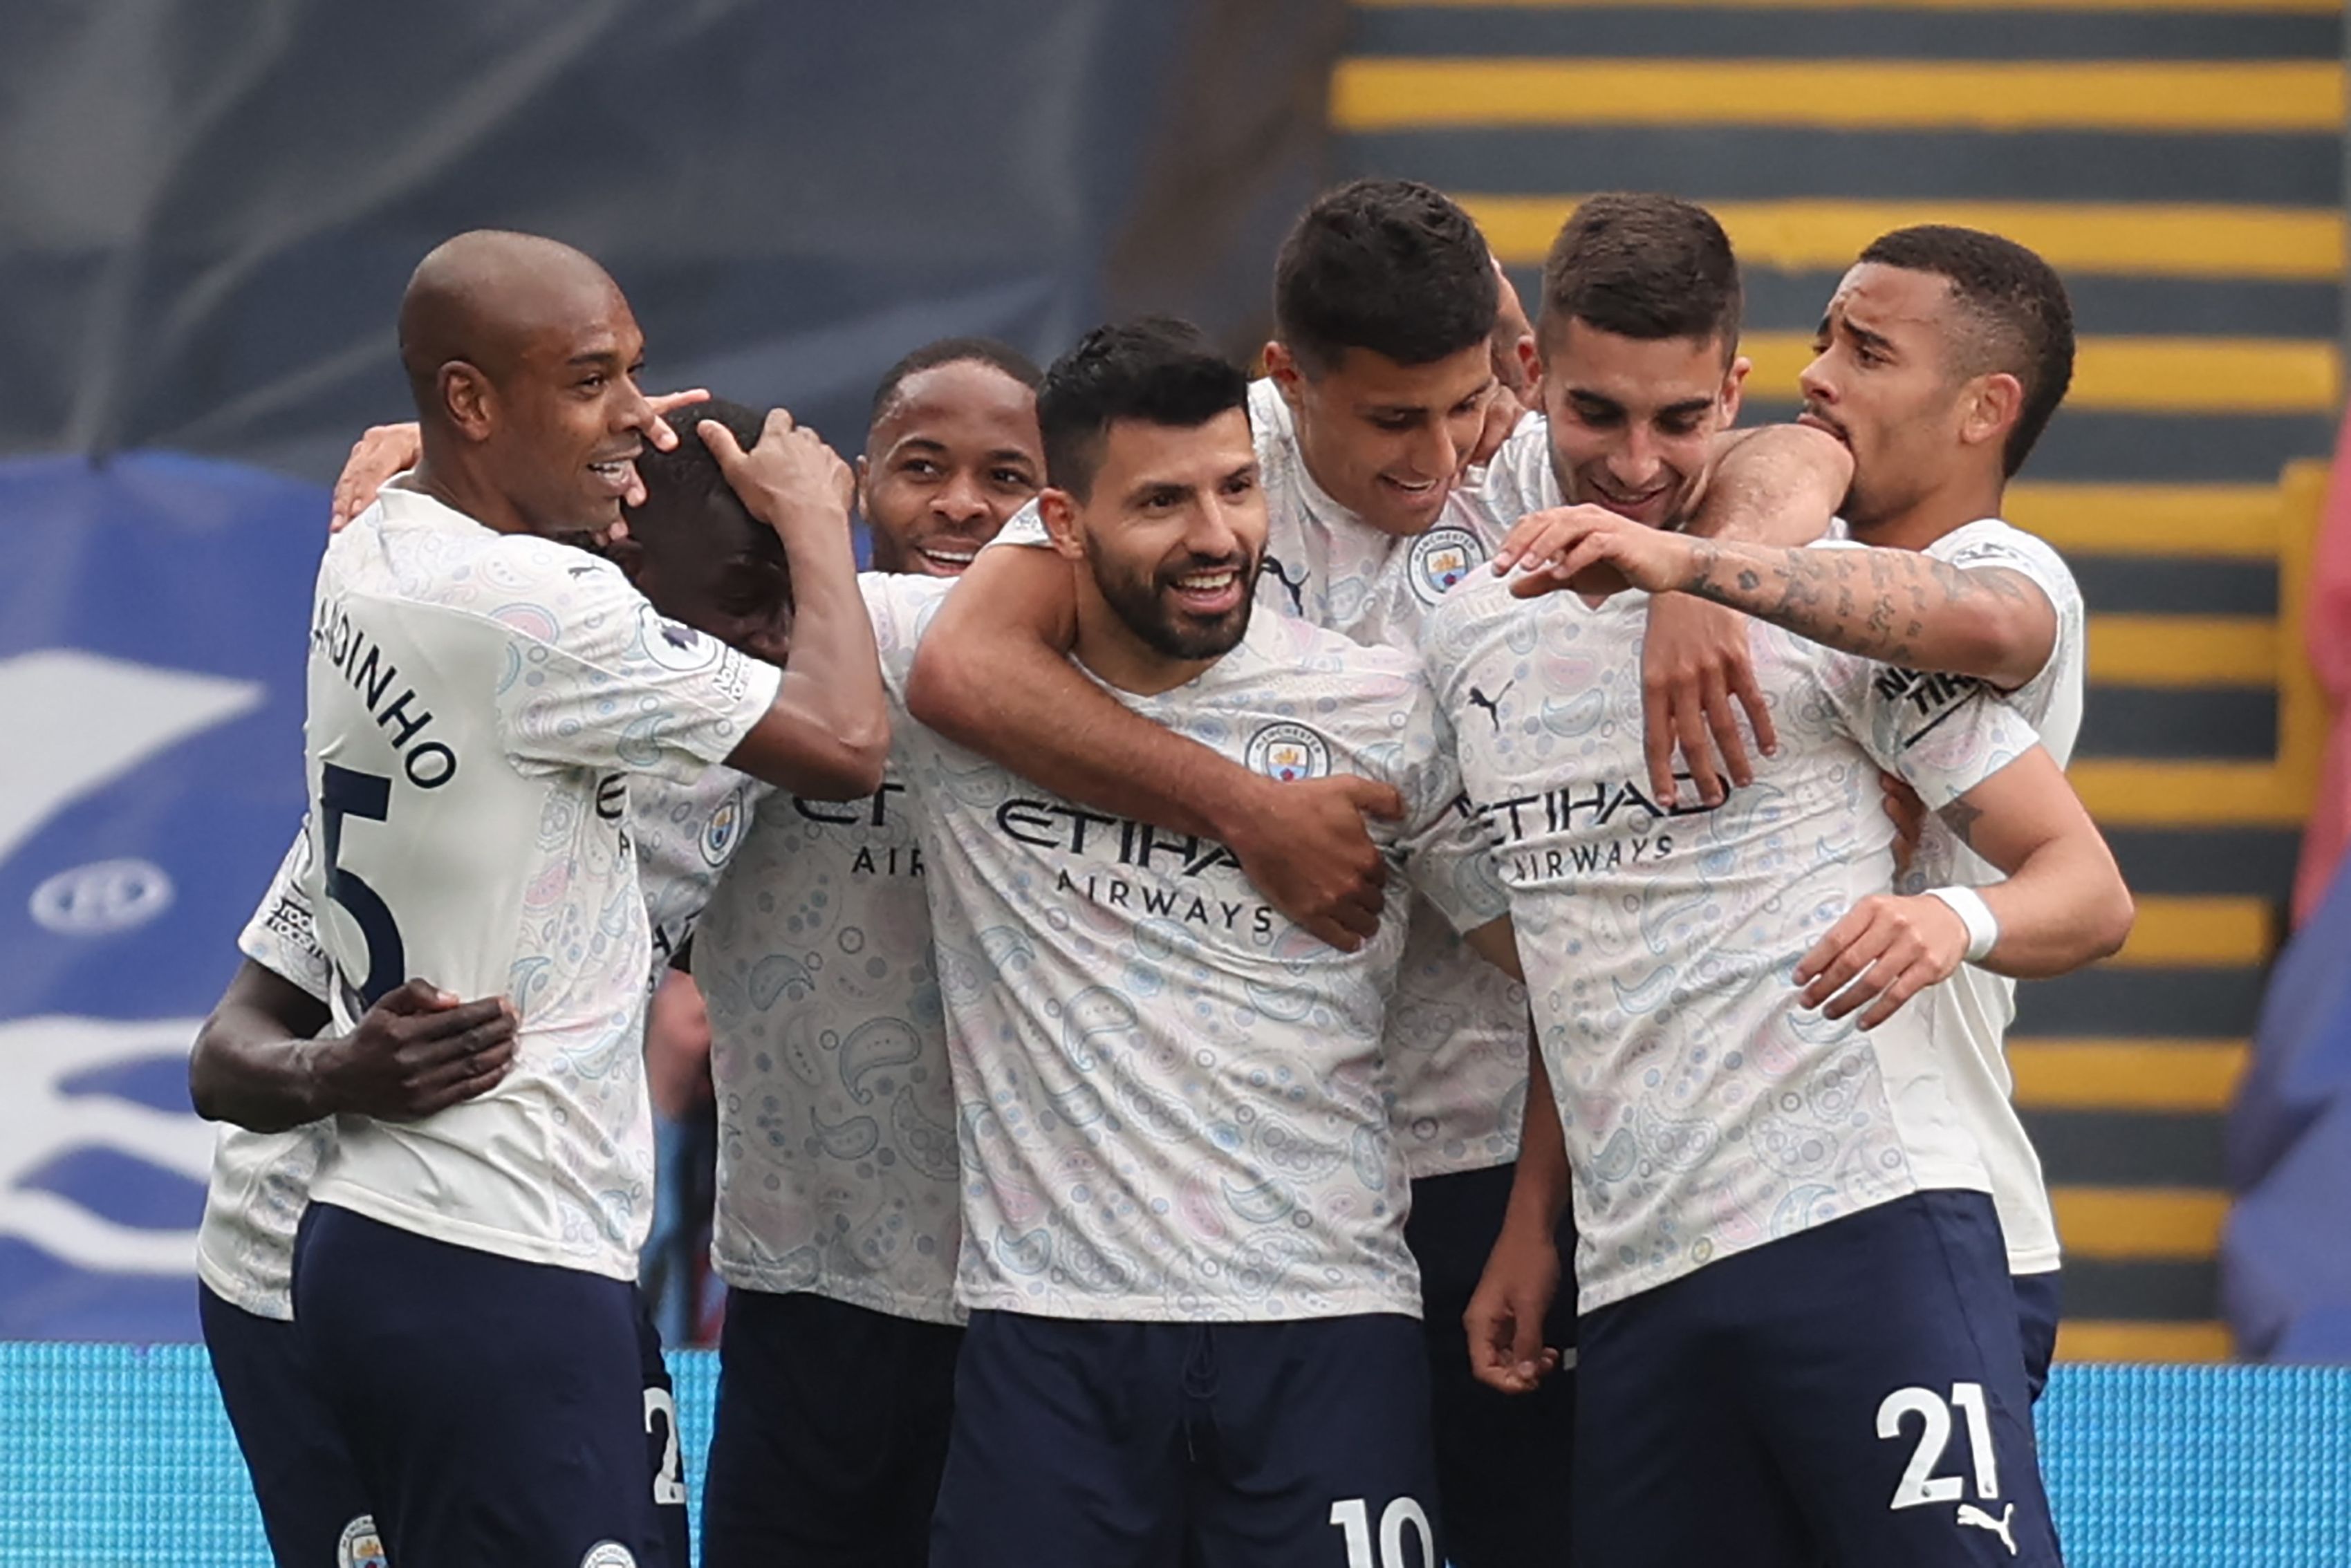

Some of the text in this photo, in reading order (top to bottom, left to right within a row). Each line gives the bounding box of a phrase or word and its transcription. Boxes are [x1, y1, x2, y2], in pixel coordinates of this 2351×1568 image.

[320, 760, 405, 1014] 5
[1057, 869, 1273, 933] AIRWAYS
[1876, 1382, 1999, 1510] 21
[1329, 1496, 1435, 1568] 10
